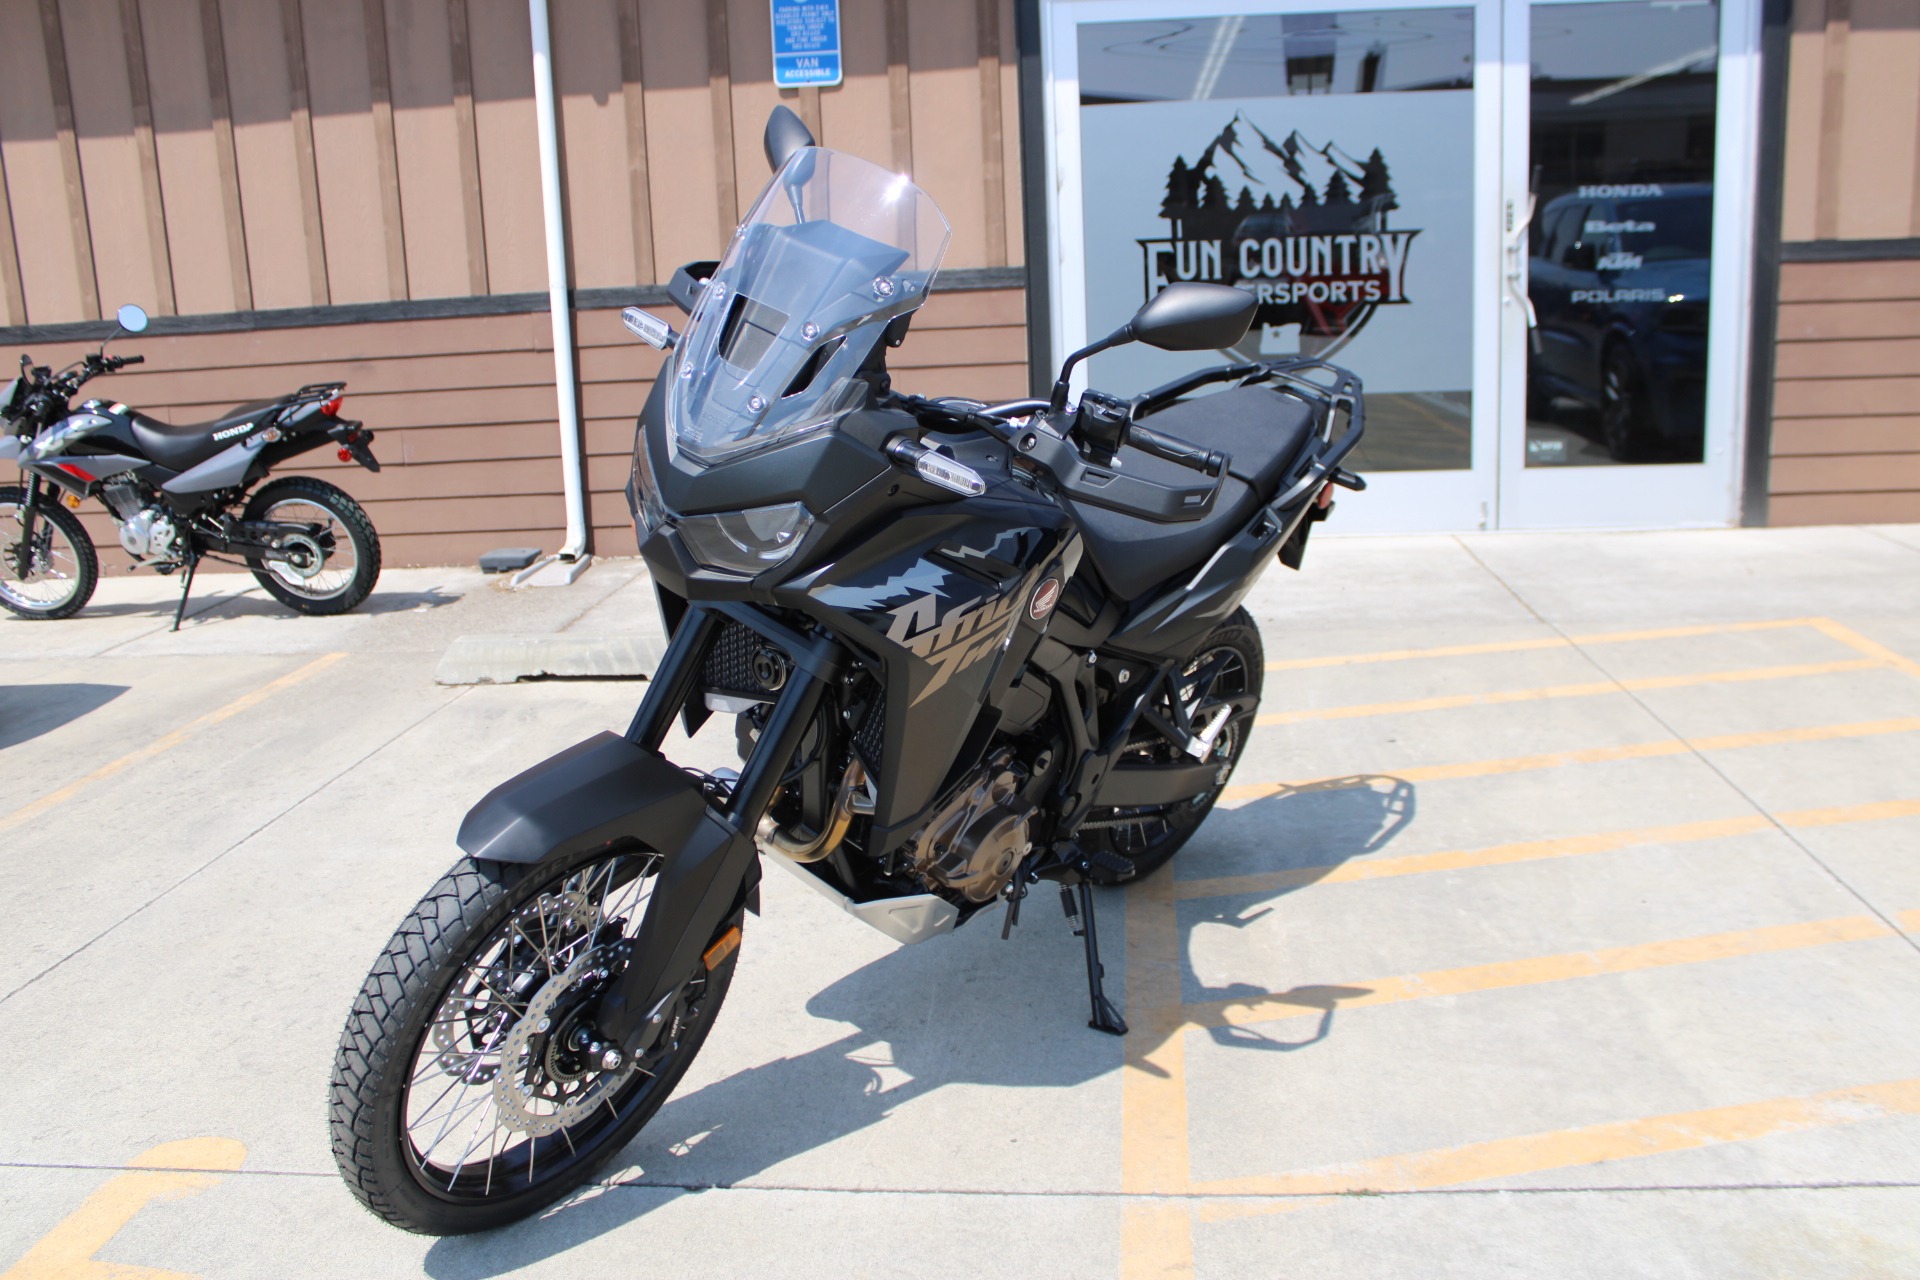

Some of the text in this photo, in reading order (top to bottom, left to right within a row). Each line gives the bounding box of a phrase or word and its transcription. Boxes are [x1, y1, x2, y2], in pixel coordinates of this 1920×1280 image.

[796, 57, 819, 68] VAN
[785, 68, 831, 77] ACCESSIBLE
[1578, 184, 1663, 198] HONDA
[1584, 220, 1656, 233] Beta
[1146, 233, 1412, 304] FUN COUNTRY
[1597, 252, 1643, 270] KTM
[1247, 280, 1381, 305] RSPORTS
[1571, 288, 1665, 303] POLARIS
[213, 422, 254, 440] HONDA
[482, 853, 577, 932] MICHEL
